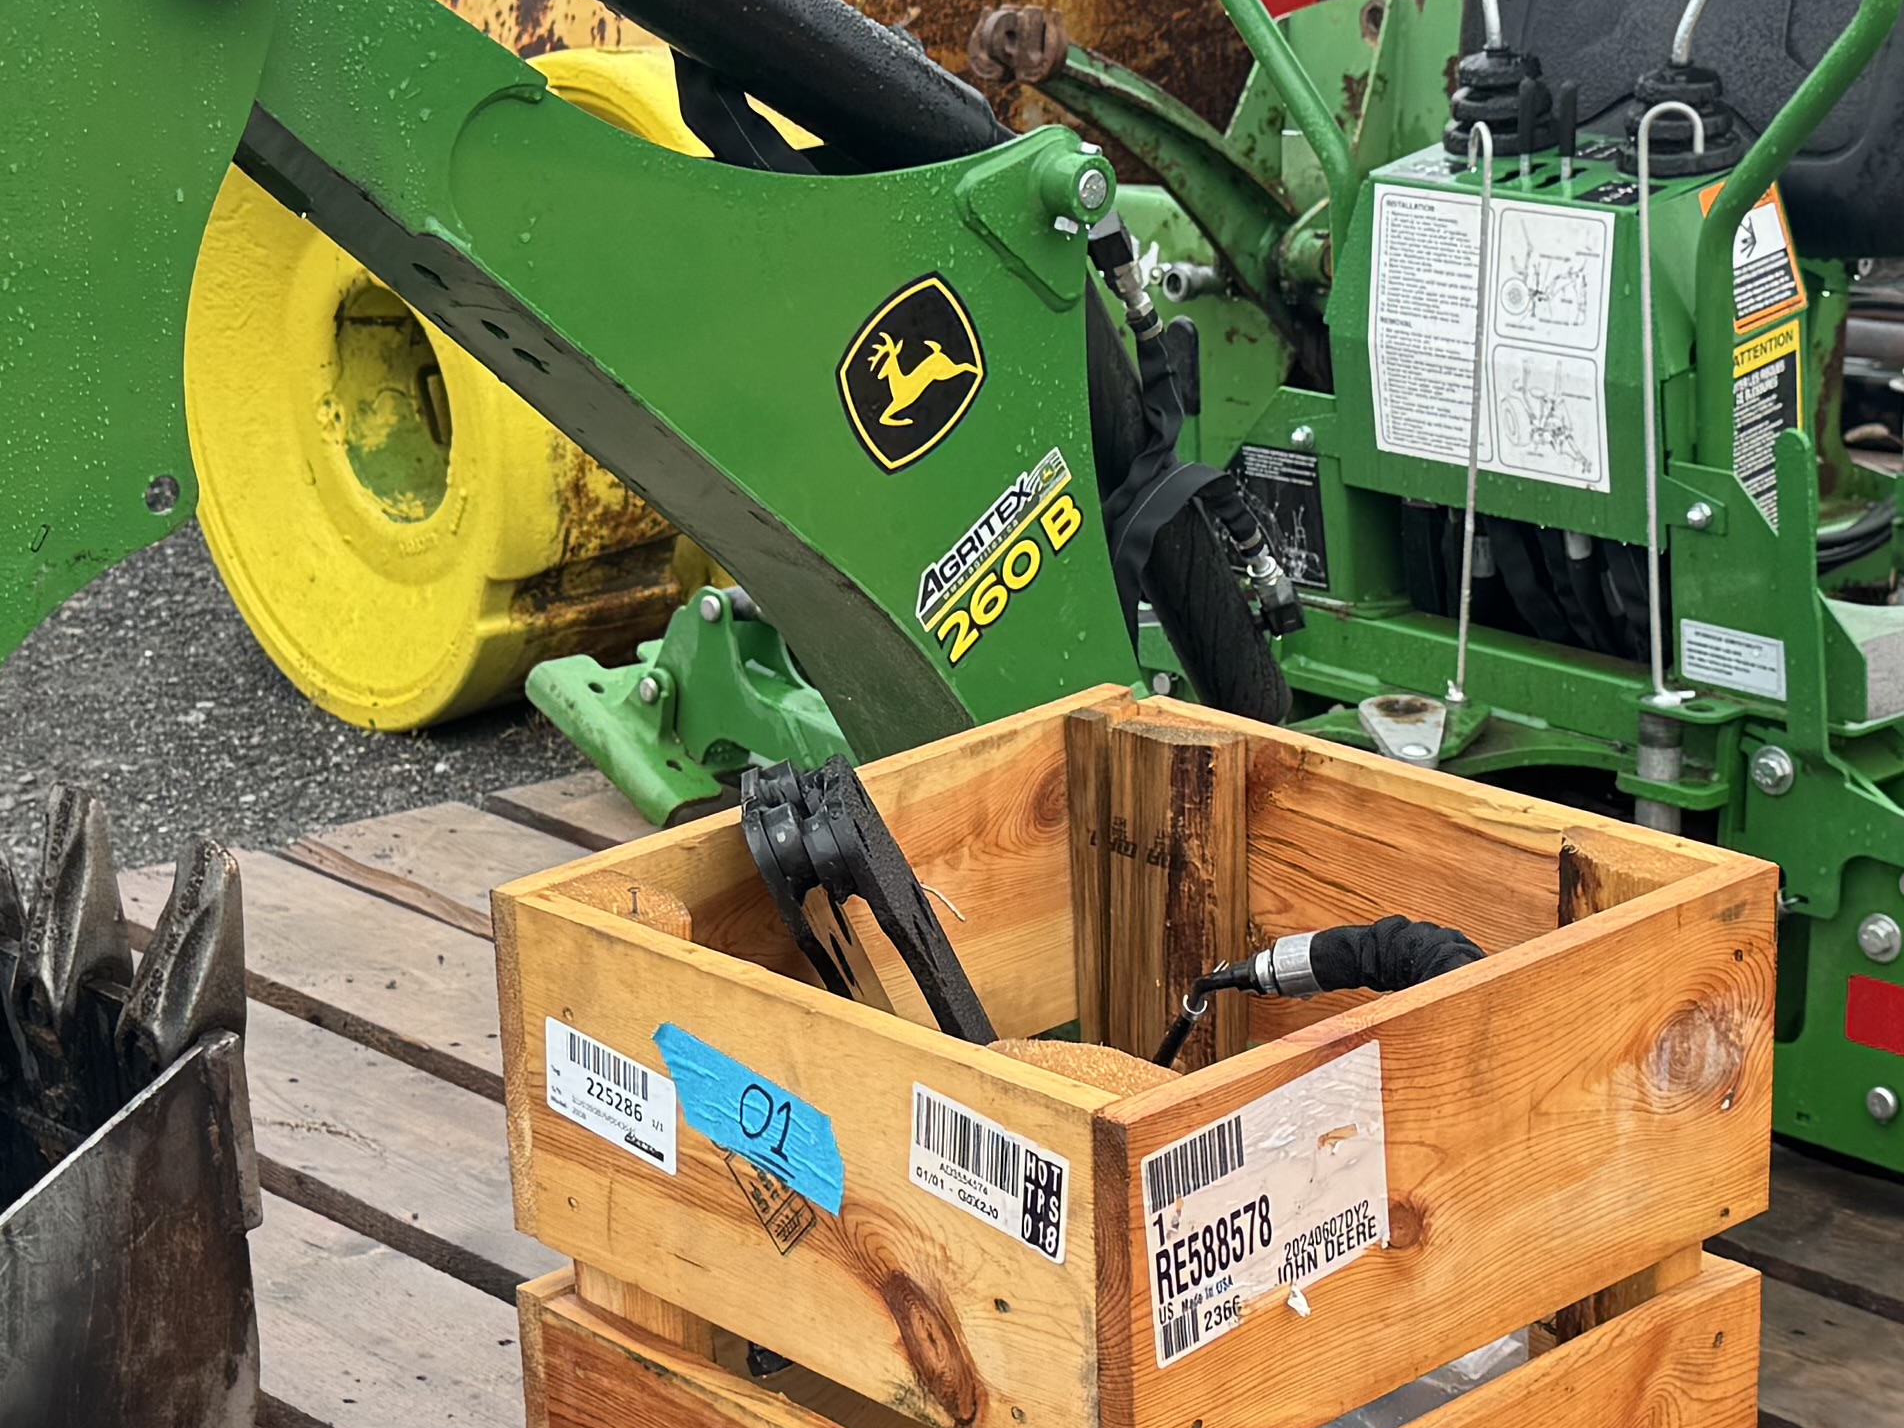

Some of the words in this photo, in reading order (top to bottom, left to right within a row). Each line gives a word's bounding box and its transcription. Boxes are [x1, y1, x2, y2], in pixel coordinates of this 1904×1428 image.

[918, 478, 1032, 615] AGRITEX
[935, 538, 1042, 666] 260
[1039, 493, 1084, 554] B
[942, 518, 1020, 601] www.agritex.ca
[586, 1076, 643, 1123] 225286
[739, 1083, 792, 1162] 01
[916, 1166, 945, 1190] 01/01
[1024, 1182, 1060, 1223] TPS
[1025, 1151, 1061, 1193] HOT
[1155, 1194, 1273, 1305] RE588578
[1274, 1249, 1319, 1287] JOHN
[1324, 1215, 1377, 1263] DEERE
[1284, 1199, 1370, 1263] 20240607DY2
[1158, 1301, 1175, 1325] US
